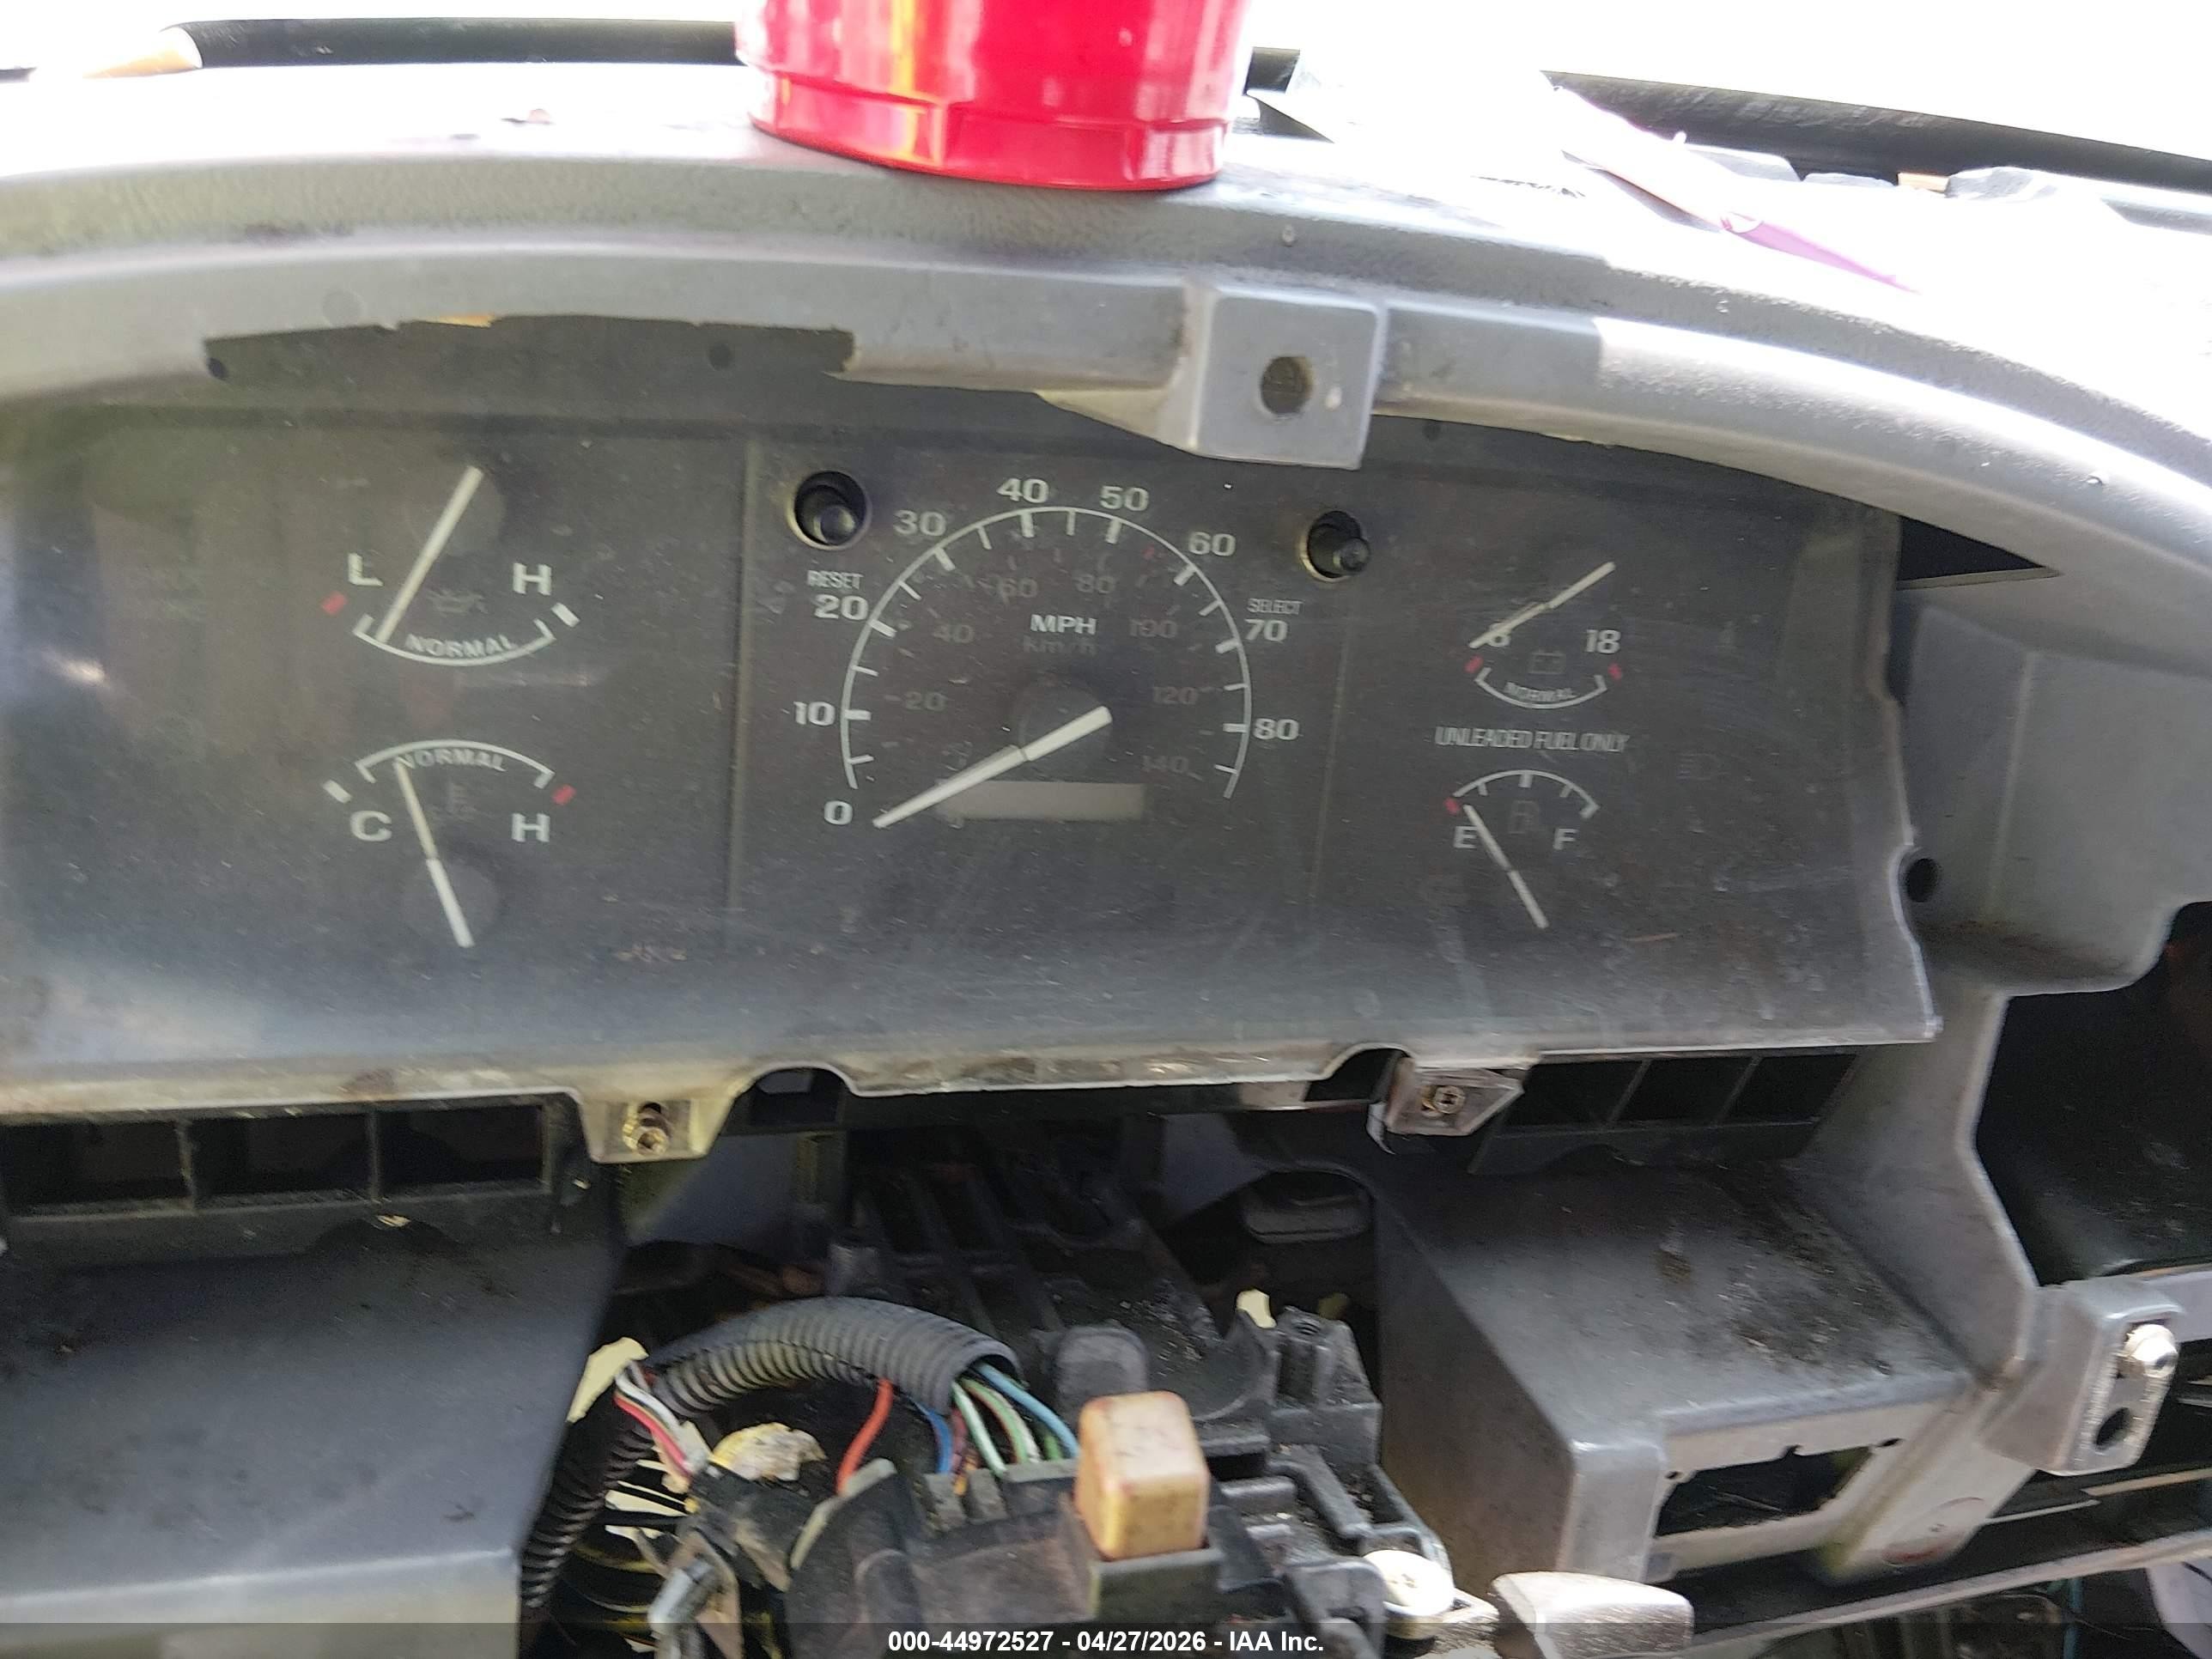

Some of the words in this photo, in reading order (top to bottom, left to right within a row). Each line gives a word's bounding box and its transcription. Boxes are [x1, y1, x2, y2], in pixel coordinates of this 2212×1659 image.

[996, 477, 1049, 503] 40
[1100, 485, 1149, 511] 50
[893, 509, 946, 537] 30
[1188, 532, 1237, 556] 60
[348, 552, 383, 586] L
[512, 562, 553, 595] H
[806, 568, 864, 590] RESET
[813, 593, 869, 621] 20
[1247, 597, 1304, 616] SELECT
[1030, 613, 1097, 635] MPH
[1244, 618, 1289, 642] 70
[404, 634, 517, 658] NORMAL
[1586, 629, 1621, 654] 18
[793, 701, 836, 726] 10
[1253, 718, 1299, 741] 80
[1435, 726, 1534, 749] UNLEADED
[1534, 732, 1579, 750] FUEL
[1579, 733, 1630, 752] ONLY
[394, 748, 507, 772] NORMAL
[823, 800, 854, 825] 0
[349, 810, 392, 842] C
[511, 812, 550, 842] H
[1453, 825, 1479, 849] E
[1553, 828, 1579, 850] F
